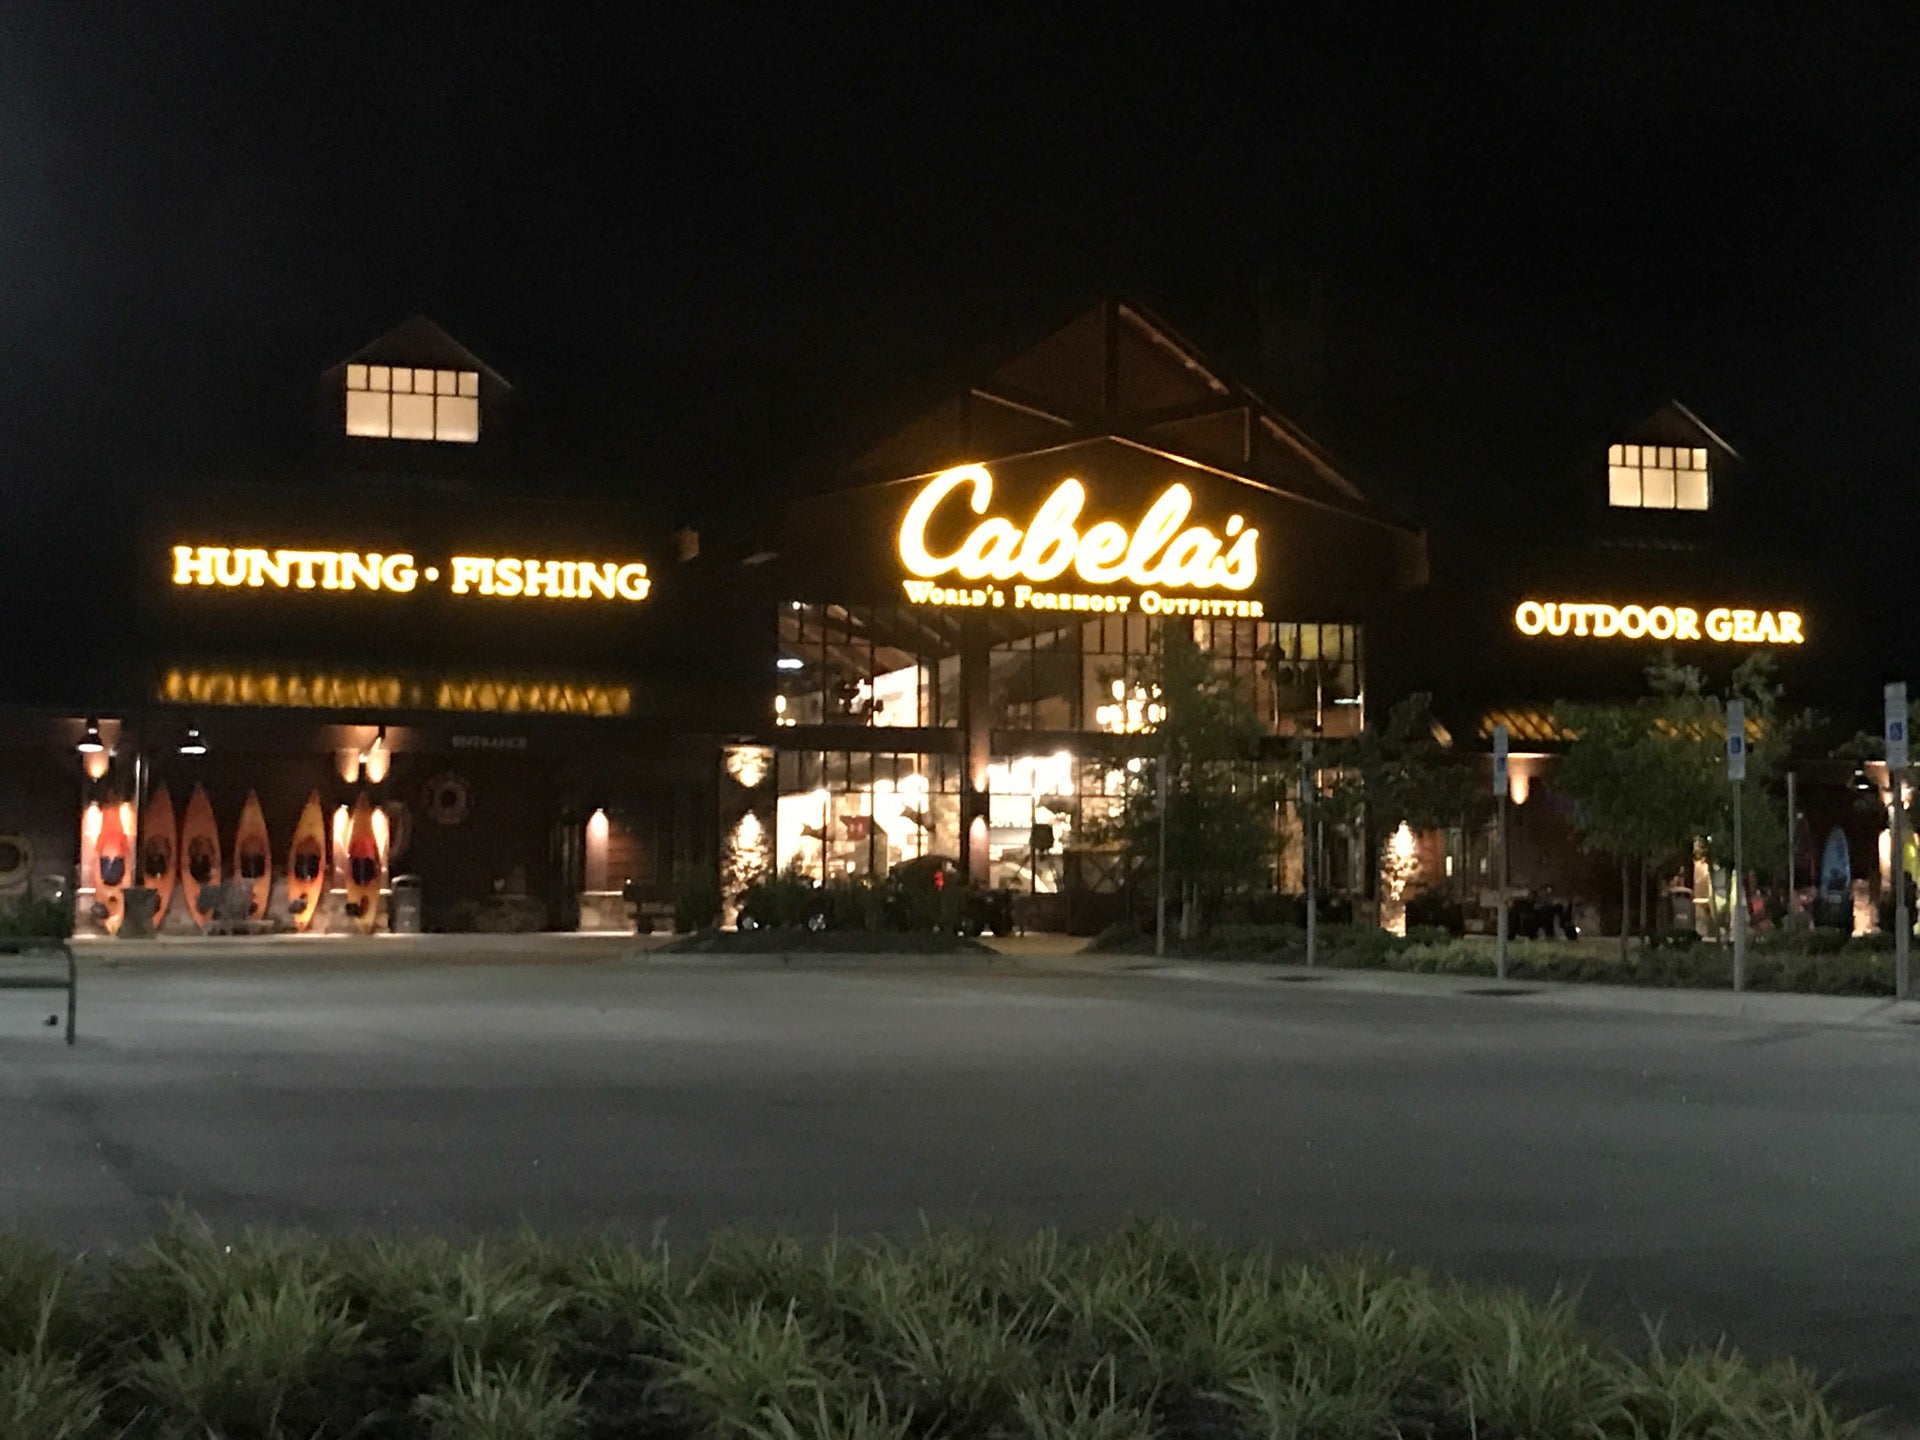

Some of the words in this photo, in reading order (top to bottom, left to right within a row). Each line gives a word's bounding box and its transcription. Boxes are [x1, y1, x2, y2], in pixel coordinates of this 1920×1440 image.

[899, 464, 1259, 590] Cabela's
[172, 545, 418, 593] HUNTING
[451, 556, 651, 600] FISHING
[903, 580, 1005, 607] WORLD'S
[1014, 584, 1131, 613] FOREMOST
[1139, 590, 1264, 617] OUTFITTER
[1515, 601, 1701, 640] OUTDOOR
[1705, 608, 1804, 644] GEAR
